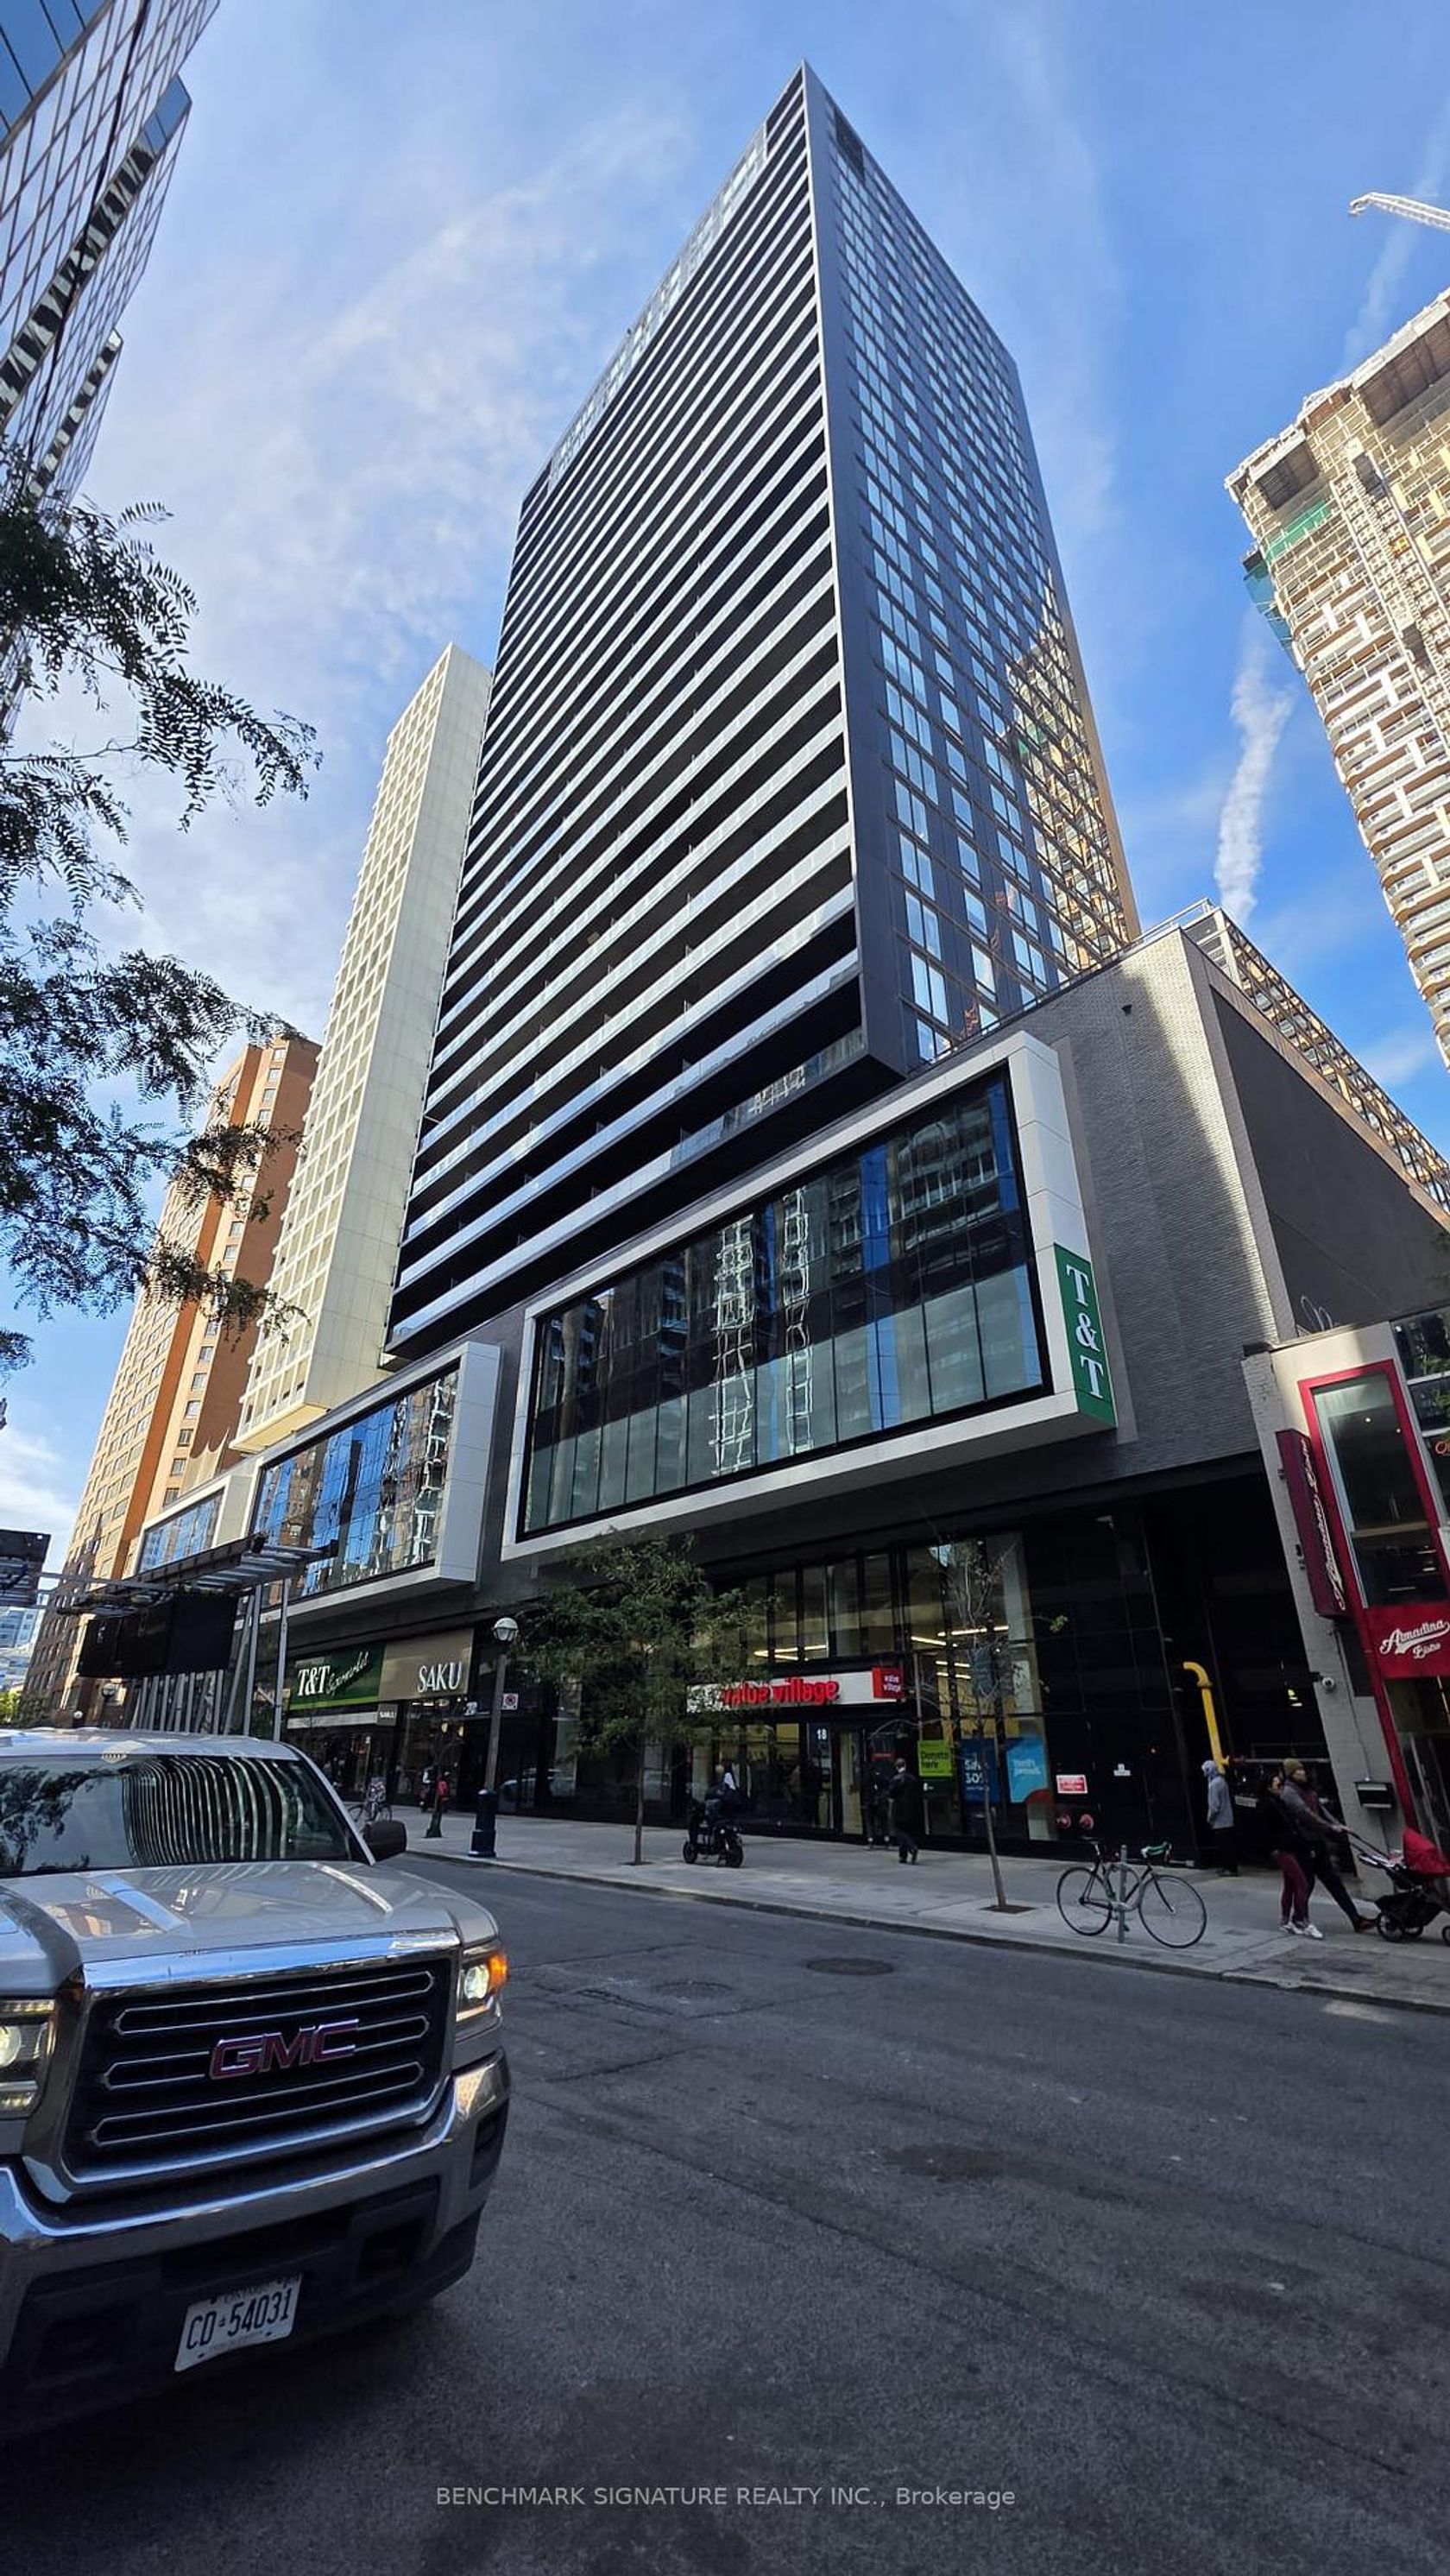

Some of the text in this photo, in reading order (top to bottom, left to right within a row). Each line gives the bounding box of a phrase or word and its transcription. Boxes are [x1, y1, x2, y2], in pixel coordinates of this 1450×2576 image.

[1066, 1264, 1104, 1399] T&T
[297, 1664, 331, 1697] T&T
[417, 1660, 463, 1694] SAKU
[772, 1676, 841, 1706] village
[209, 2018, 359, 2080] GMC
